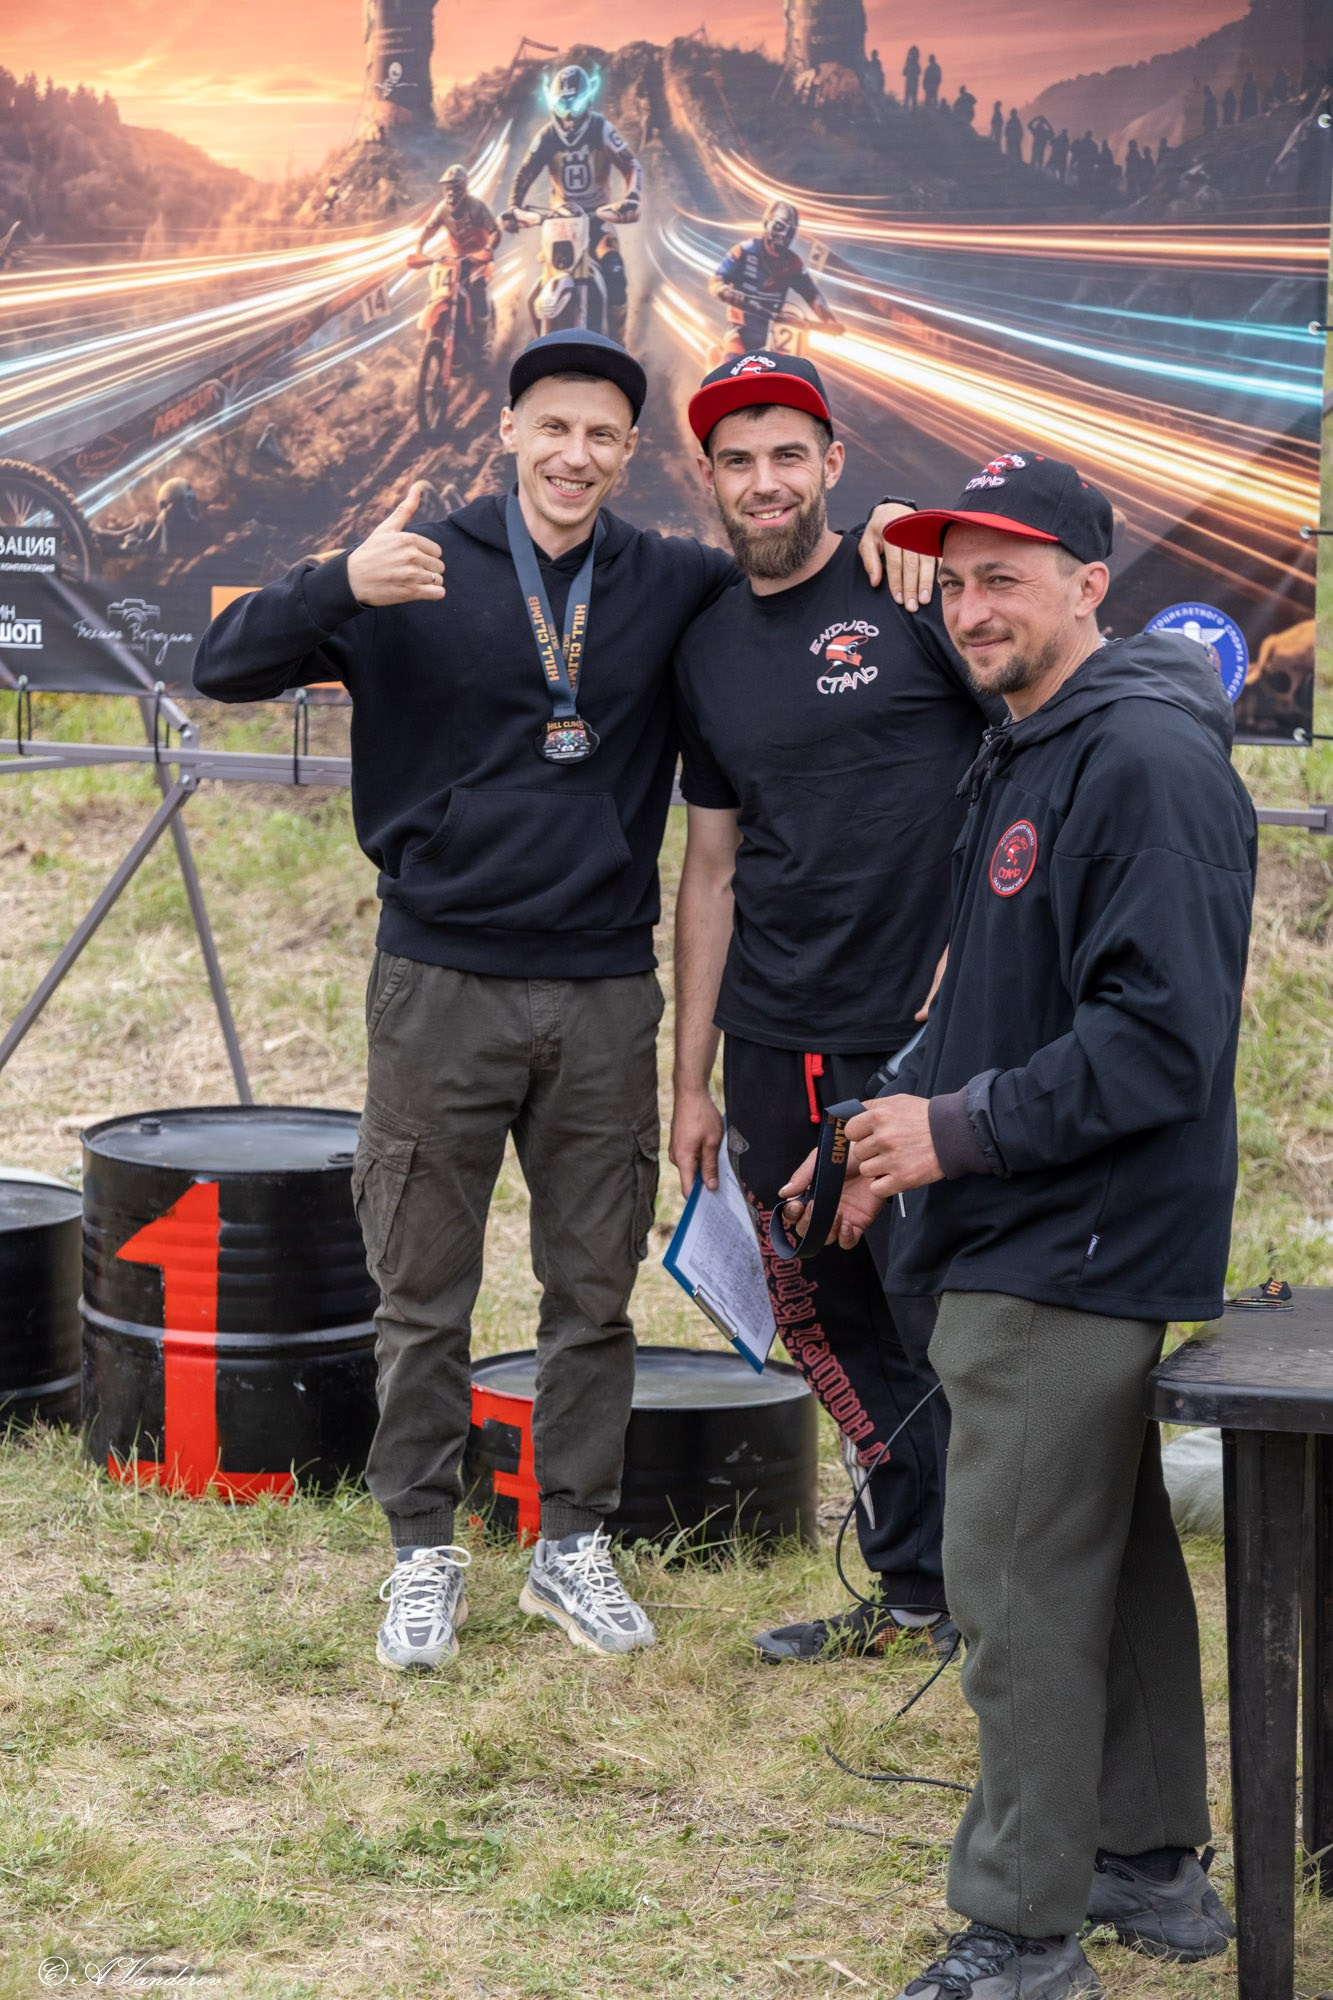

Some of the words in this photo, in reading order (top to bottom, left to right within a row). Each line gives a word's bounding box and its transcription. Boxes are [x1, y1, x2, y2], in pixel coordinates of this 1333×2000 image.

[528, 595, 550, 644] CLIMB
[572, 604, 587, 639] HILL
[808, 619, 880, 656] ENDURO
[542, 645, 560, 681] HILL
[109, 1182, 294, 1504] 1
